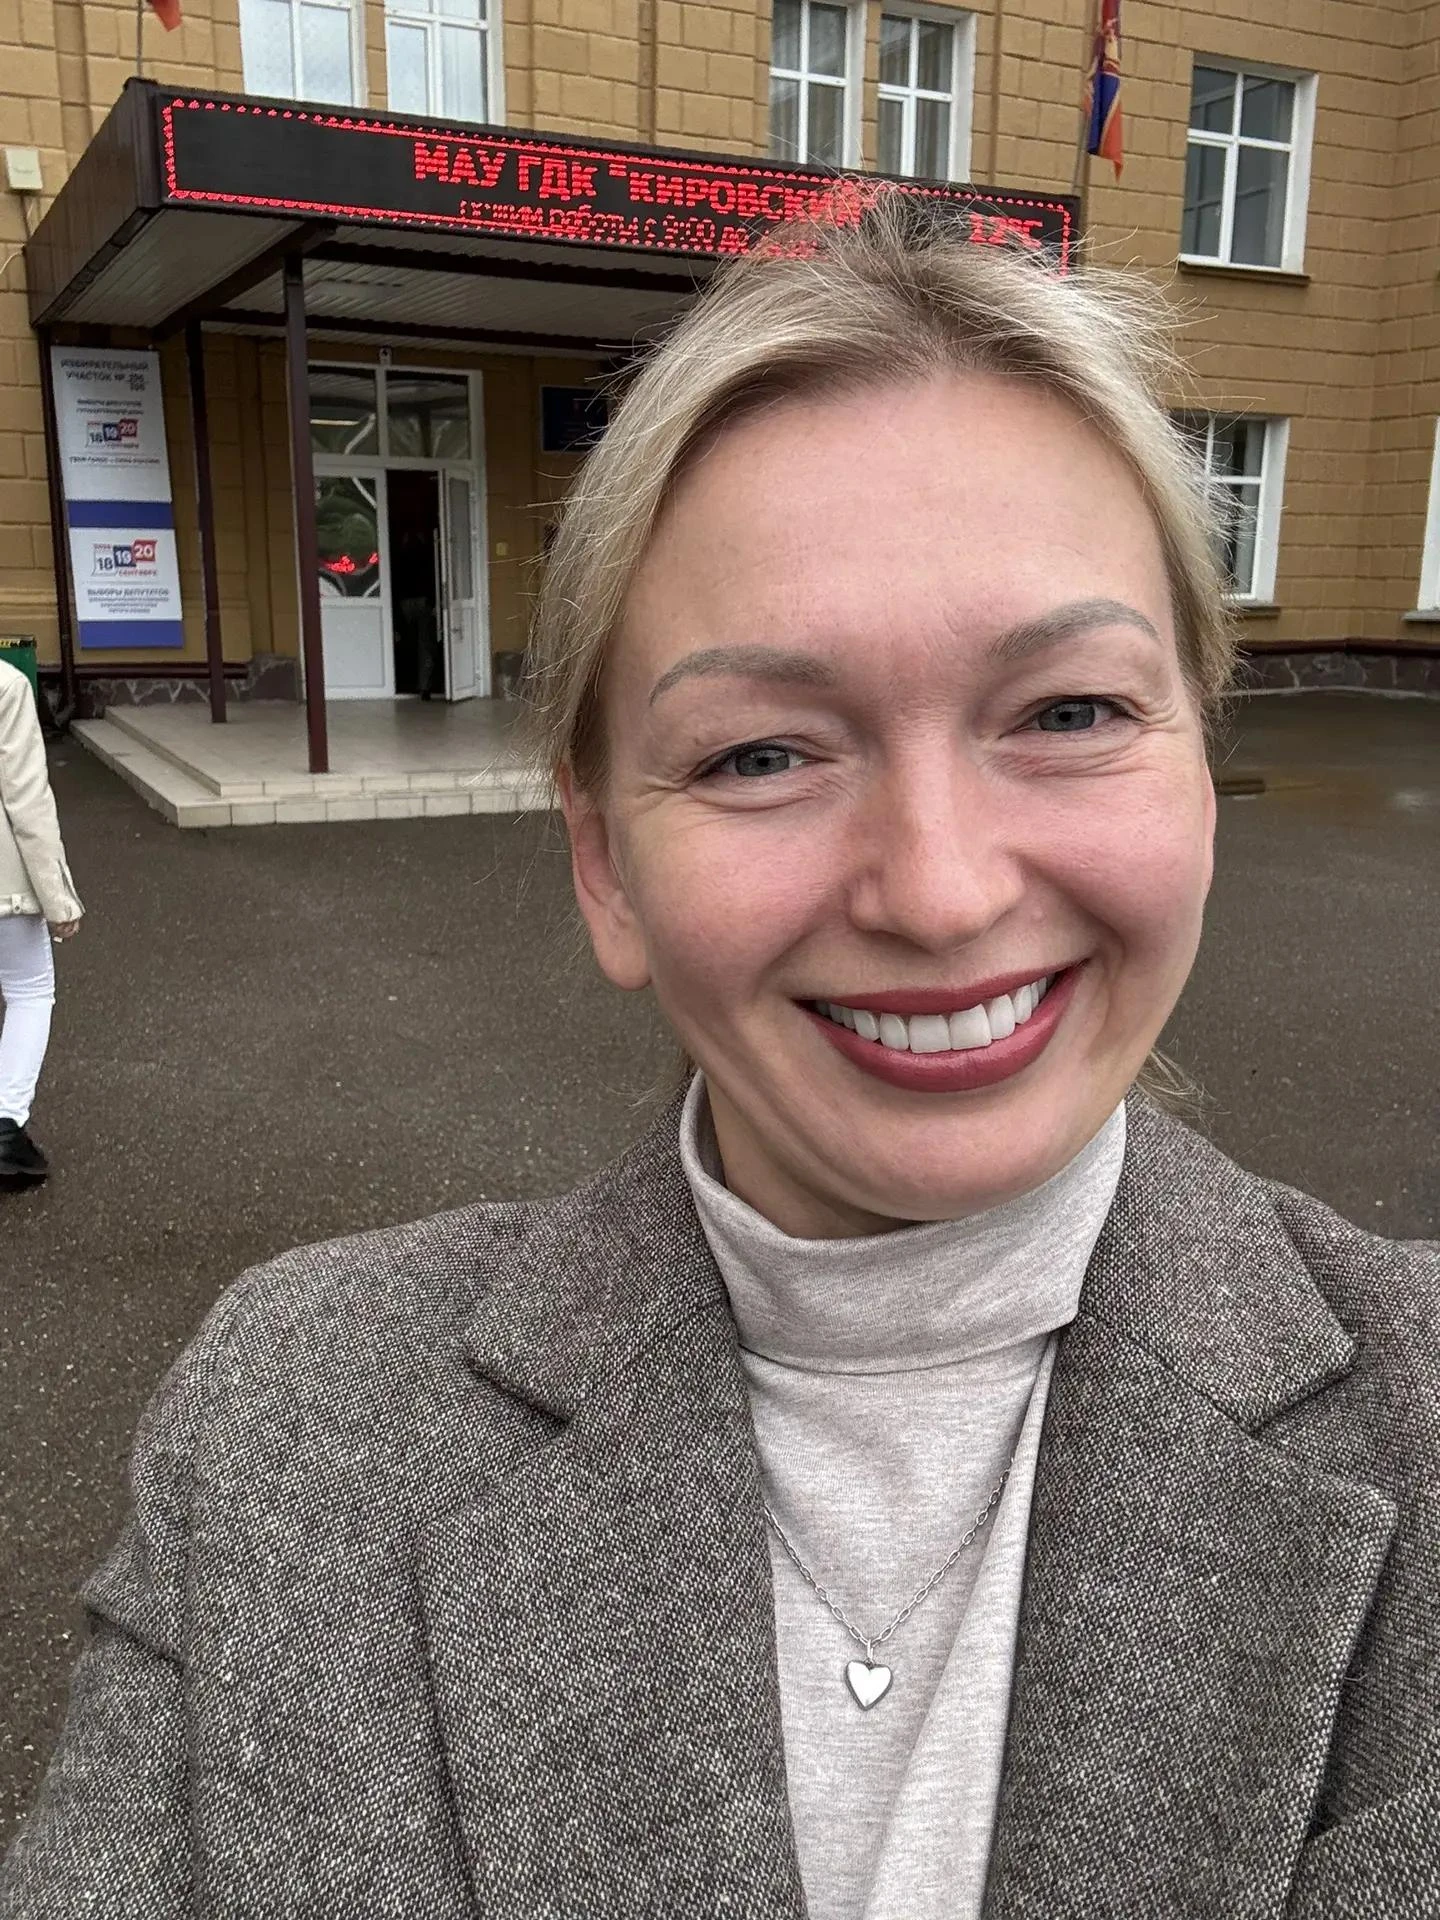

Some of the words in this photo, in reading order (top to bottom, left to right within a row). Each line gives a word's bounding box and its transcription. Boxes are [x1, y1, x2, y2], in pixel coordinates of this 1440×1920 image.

[414, 142, 506, 187] МАУ
[518, 154, 599, 201] ГДК
[120, 422, 136, 436] 20
[96, 556, 114, 571] 18
[115, 550, 132, 564] 19
[134, 544, 154, 558] 20
